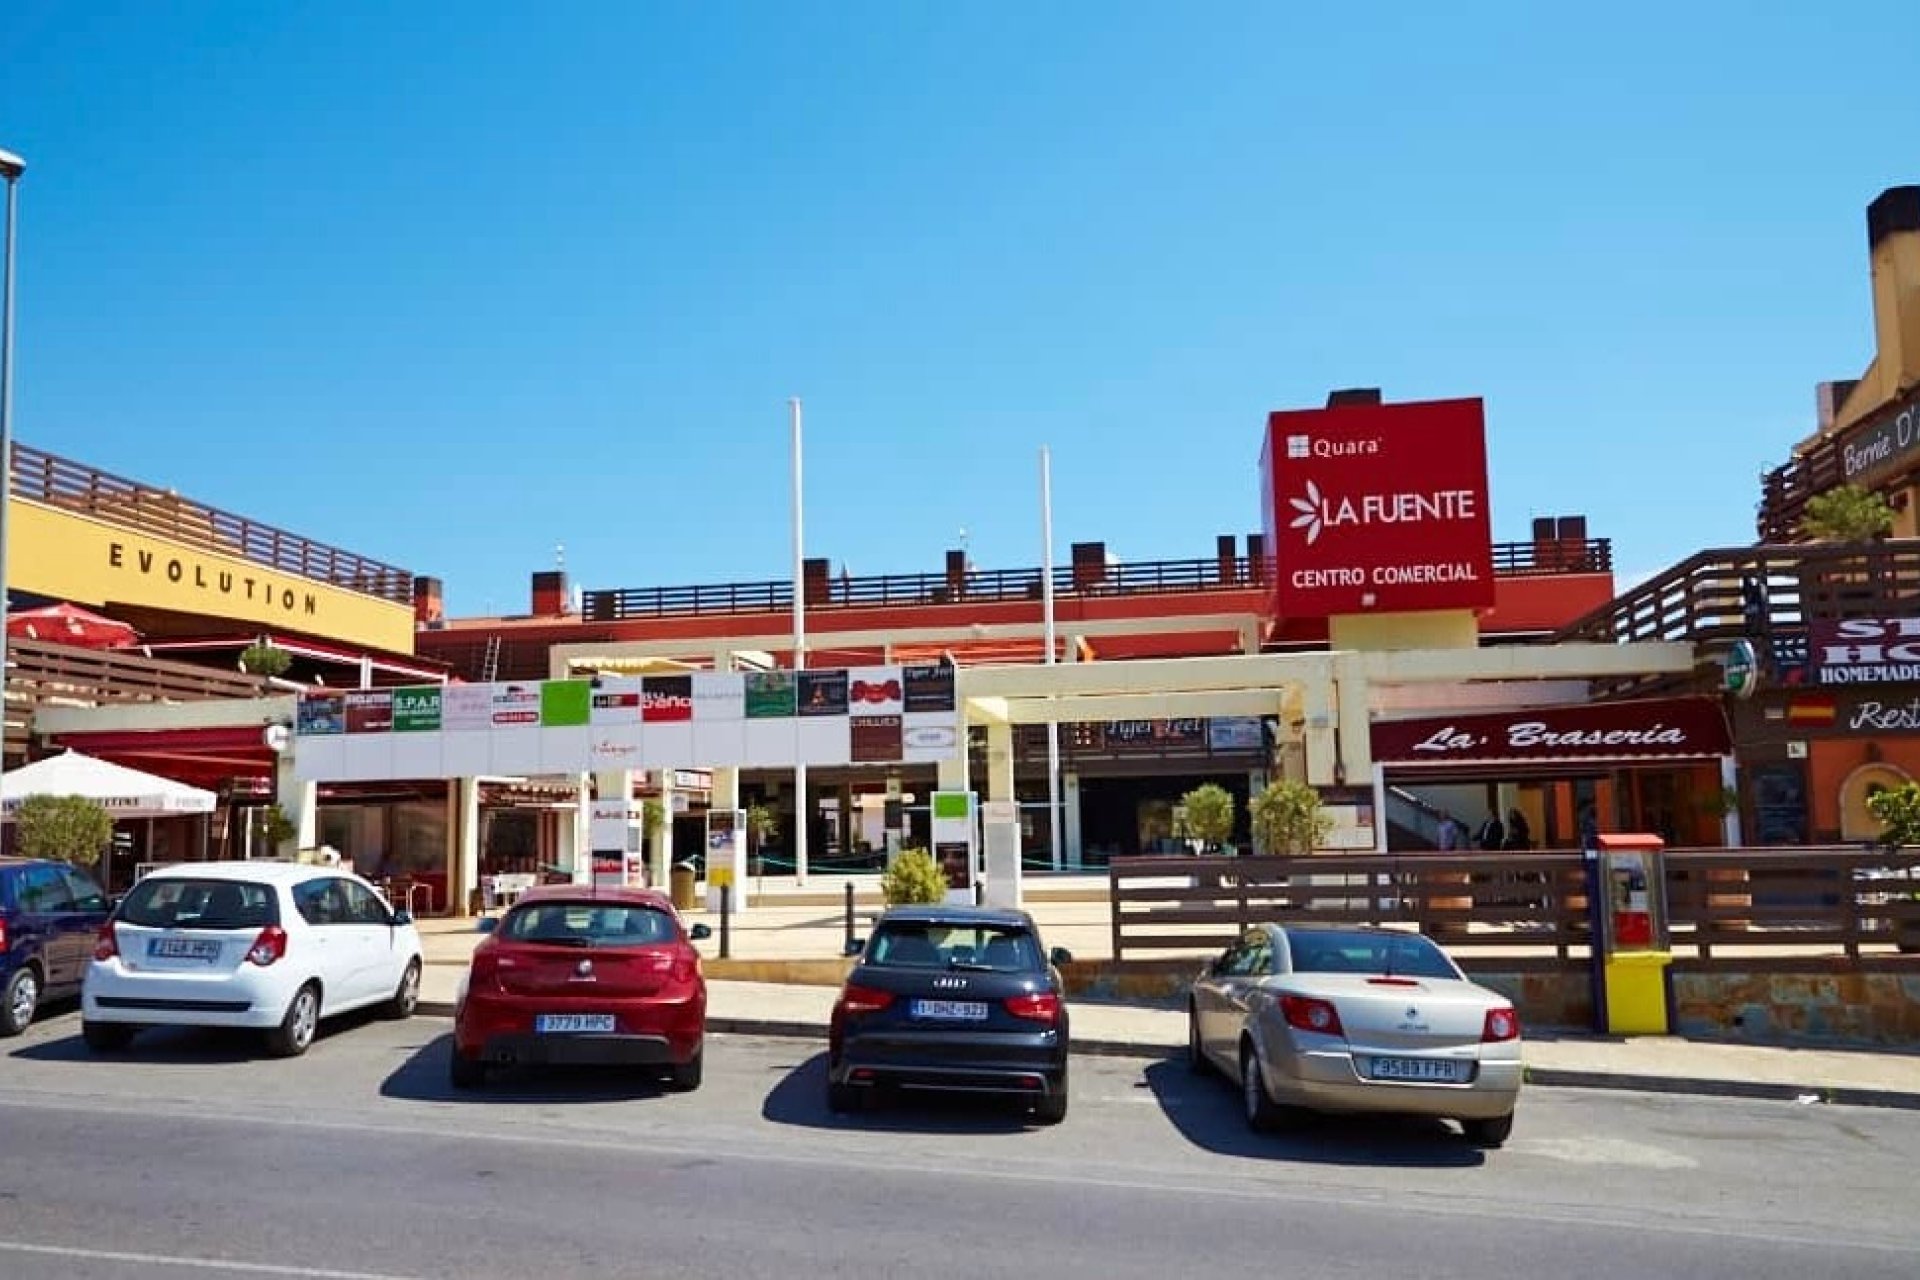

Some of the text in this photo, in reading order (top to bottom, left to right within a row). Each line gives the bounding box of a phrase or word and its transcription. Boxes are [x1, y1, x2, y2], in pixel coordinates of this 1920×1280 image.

[1313, 437, 1379, 458] Quara
[1322, 490, 1475, 526] LA FUENTE
[109, 543, 317, 615] EVOLUTION
[1292, 562, 1478, 588] CENTRO COMERCIAL
